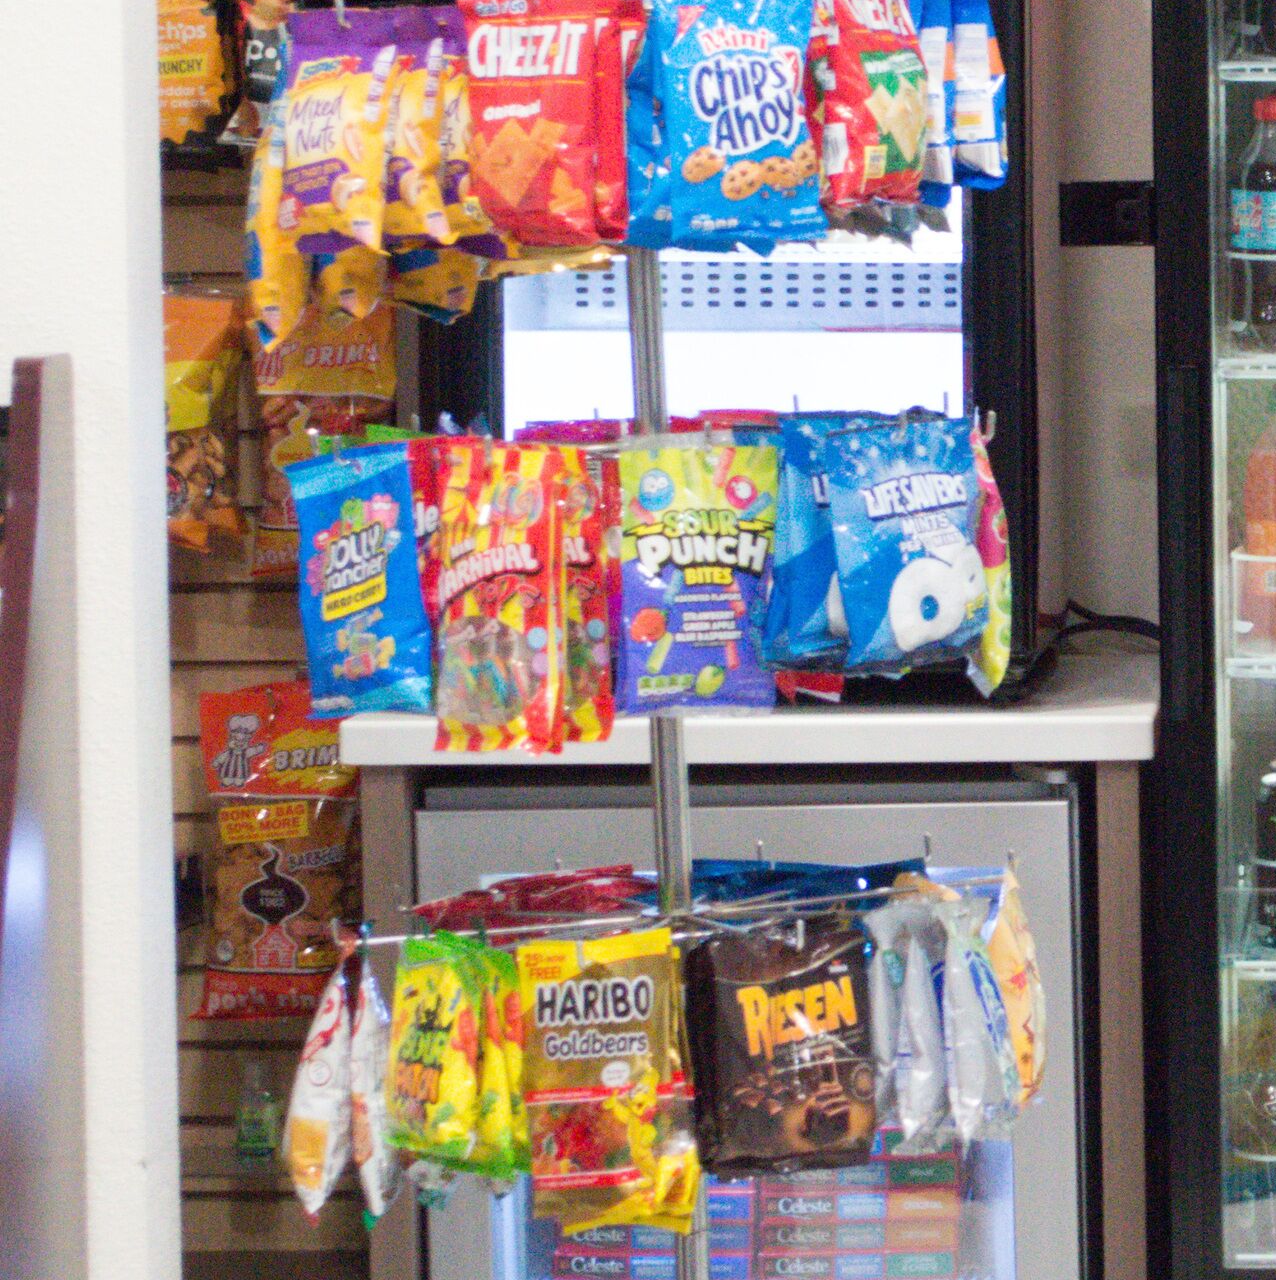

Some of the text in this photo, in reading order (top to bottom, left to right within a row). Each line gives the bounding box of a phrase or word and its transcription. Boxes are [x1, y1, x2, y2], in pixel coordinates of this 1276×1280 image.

[695, 57, 788, 117] Chips
[289, 85, 348, 125] Mixed
[295, 122, 337, 158] Nuts
[663, 509, 739, 539] SOUR
[636, 532, 770, 577] PUNCH
[684, 567, 735, 586] BITES
[537, 980, 651, 1024] HARIBO
[545, 1032, 649, 1059] Goldbears
[777, 1197, 833, 1216] Celeste
[570, 1256, 625, 1274] Celeste
[775, 1258, 830, 1276] Celeste
